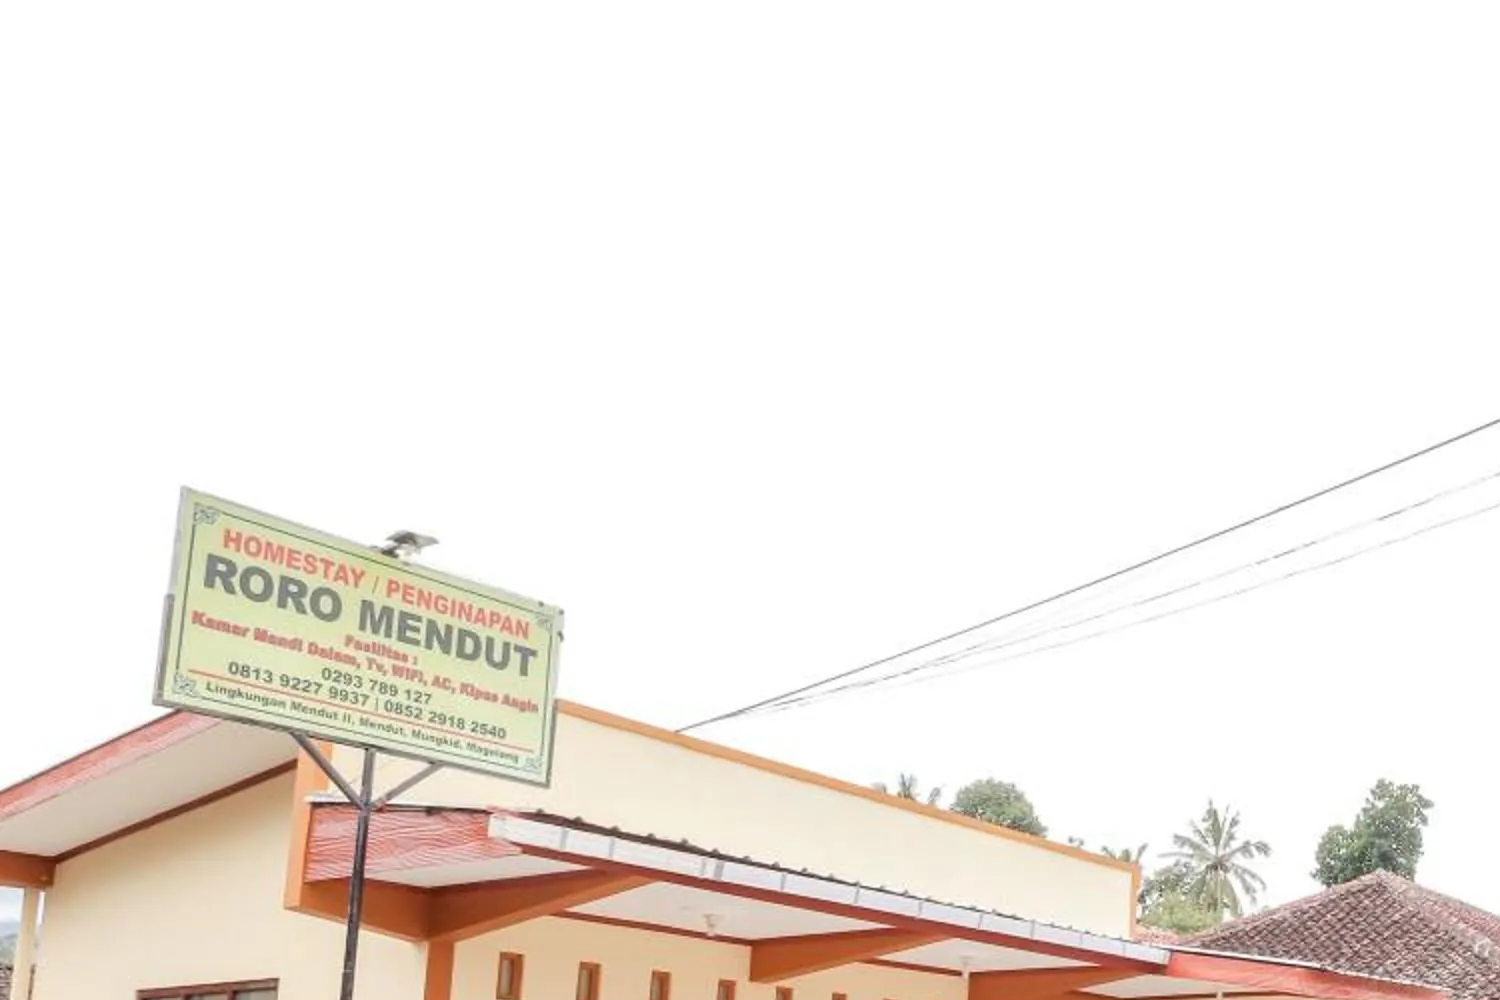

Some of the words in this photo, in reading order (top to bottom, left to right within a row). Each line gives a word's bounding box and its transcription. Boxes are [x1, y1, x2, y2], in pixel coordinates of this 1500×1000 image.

[203, 553, 343, 622] RORO
[358, 599, 538, 677] MENDUT
[222, 528, 365, 588] HOMESTAY
[386, 578, 530, 640] PENGINAPAN
[191, 610, 250, 638] Kamar
[254, 627, 303, 651] Mandi
[308, 642, 361, 669] Dalam,
[205, 681, 287, 709] Lingkungan
[290, 701, 338, 721] Mendut
[359, 717, 407, 738] Mendut,
[228, 661, 273, 683] 0813
[279, 673, 322, 695] 9227
[328, 686, 370, 707] 9937
[384, 699, 423, 721] 0852
[428, 711, 465, 731] 2918
[470, 721, 507, 740] 2540
[321, 667, 363, 689] 0293
[369, 679, 399, 697] 789
[405, 688, 432, 705] 127
